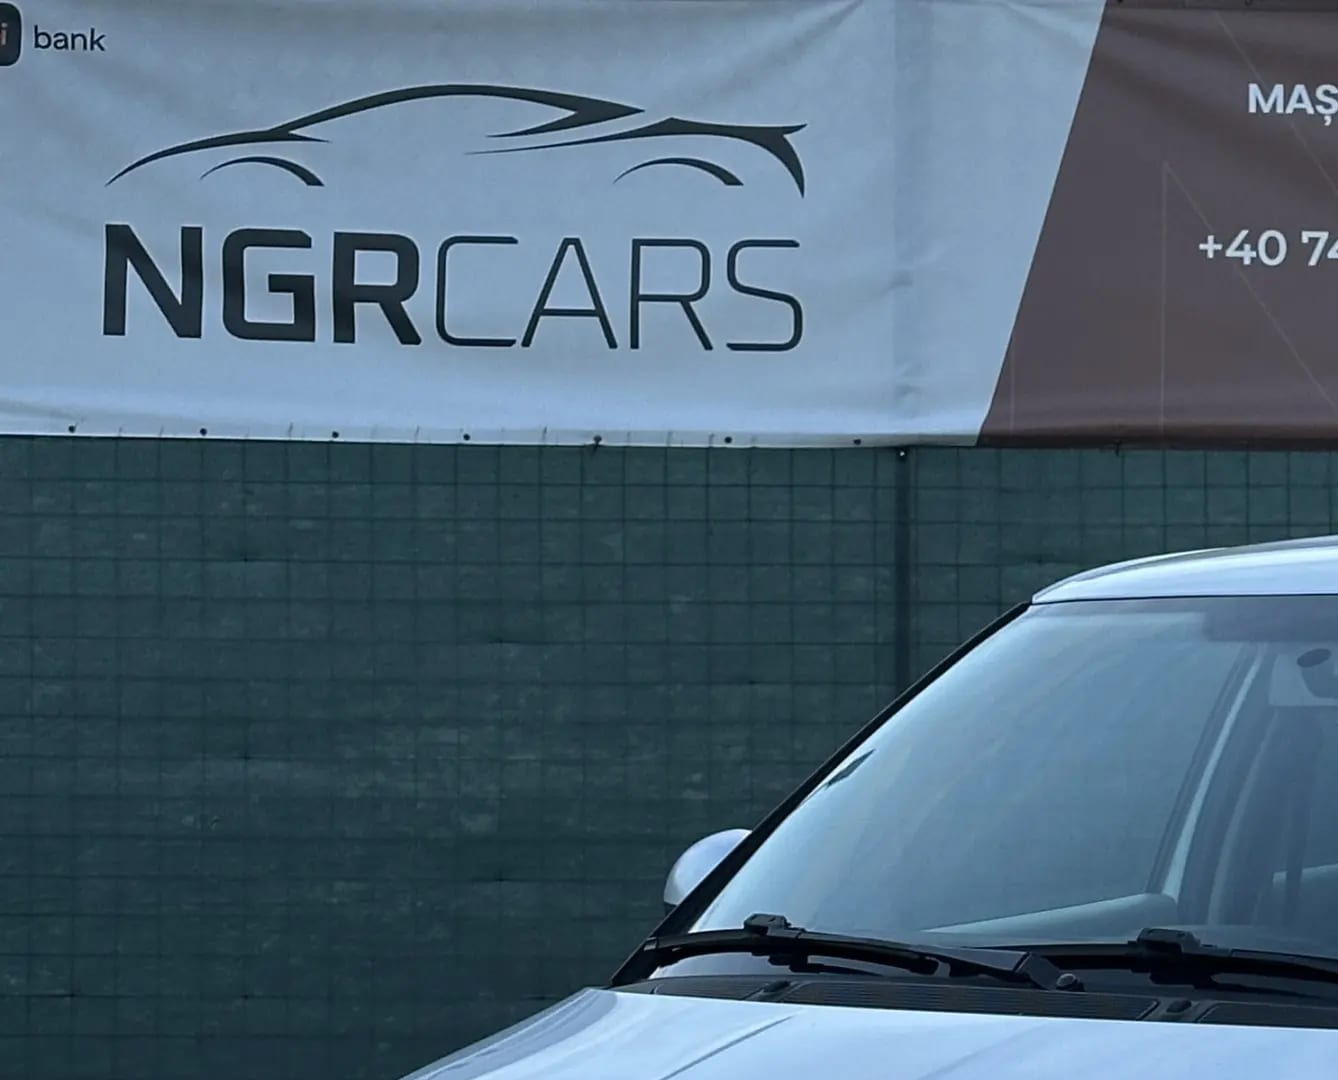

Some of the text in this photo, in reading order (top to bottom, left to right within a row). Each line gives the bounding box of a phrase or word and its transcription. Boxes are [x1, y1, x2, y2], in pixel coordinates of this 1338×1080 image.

[34, 25, 105, 51] bank
[1199, 230, 1286, 265] +40
[103, 224, 802, 351] NGRCARS
